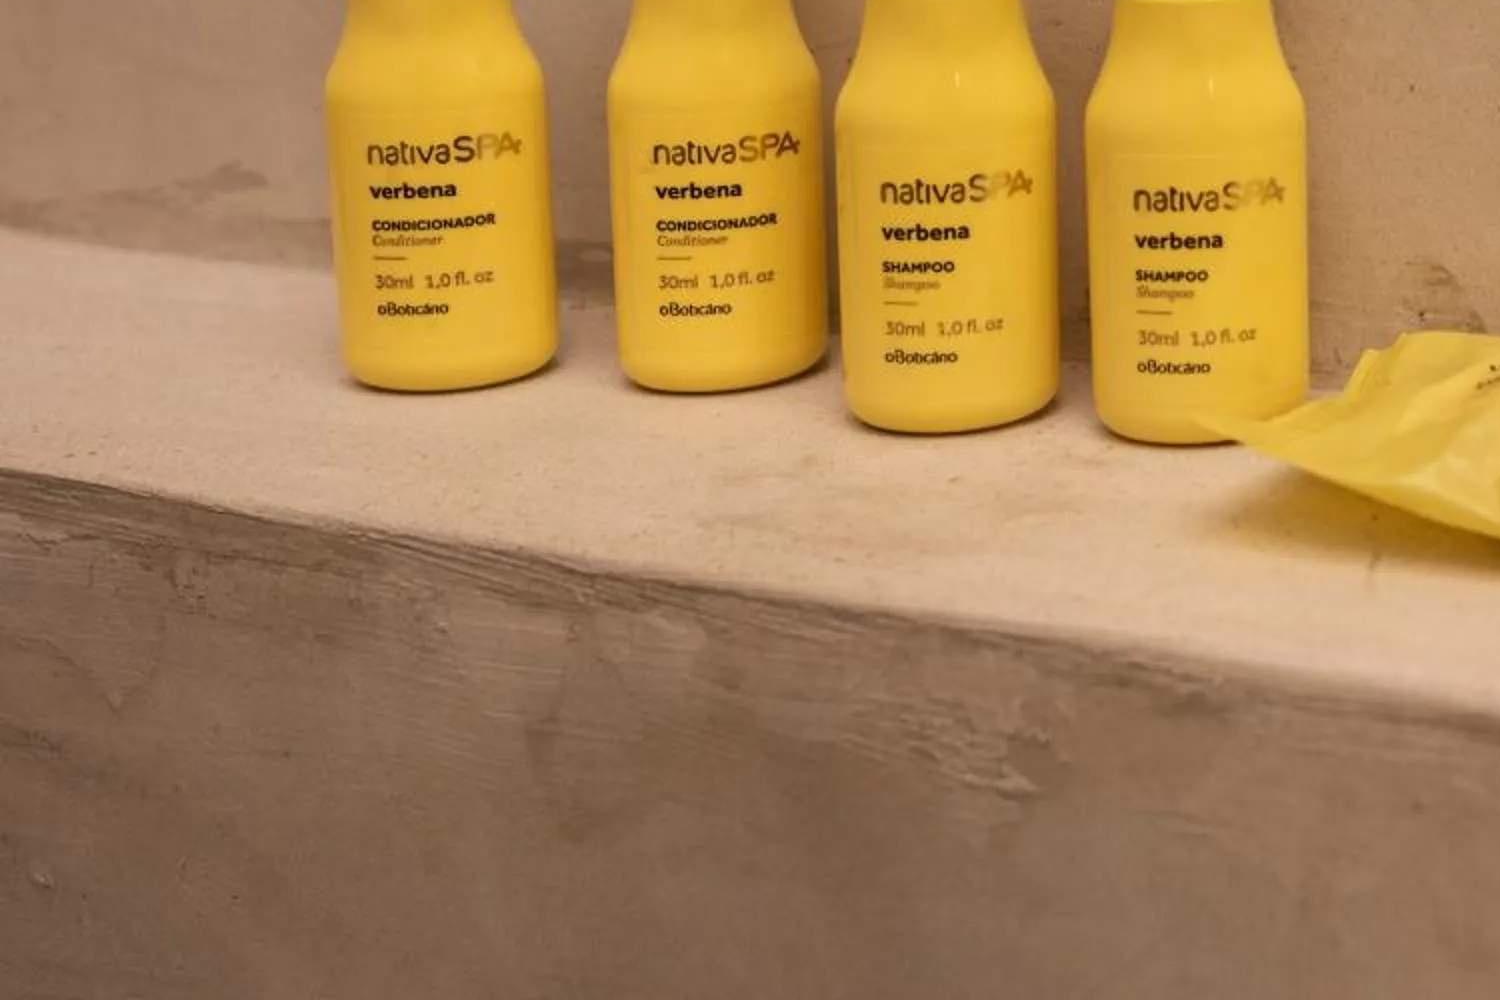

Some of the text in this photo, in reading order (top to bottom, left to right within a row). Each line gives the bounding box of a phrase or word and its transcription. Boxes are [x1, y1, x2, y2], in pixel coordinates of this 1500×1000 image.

[370, 182, 457, 199] verbena
[656, 182, 742, 199] verbena
[372, 213, 496, 231] CONDICIONADOR
[656, 213, 777, 231] CONDICIONADOR
[372, 235, 443, 247] Conditioner
[657, 235, 728, 247] Conditioner
[882, 224, 970, 241] verbena
[1135, 232, 1223, 249] verbena
[882, 261, 954, 273] SHAMPOO
[376, 274, 413, 289] 30ml
[474, 270, 494, 284] oz
[659, 275, 698, 289] 30ml
[757, 270, 774, 283] oz
[1136, 270, 1208, 282] SHAMPOO
[886, 322, 925, 336] 30ml
[986, 318, 1003, 332] oz
[1139, 330, 1179, 345] 30ml
[1239, 329, 1256, 341] oz
